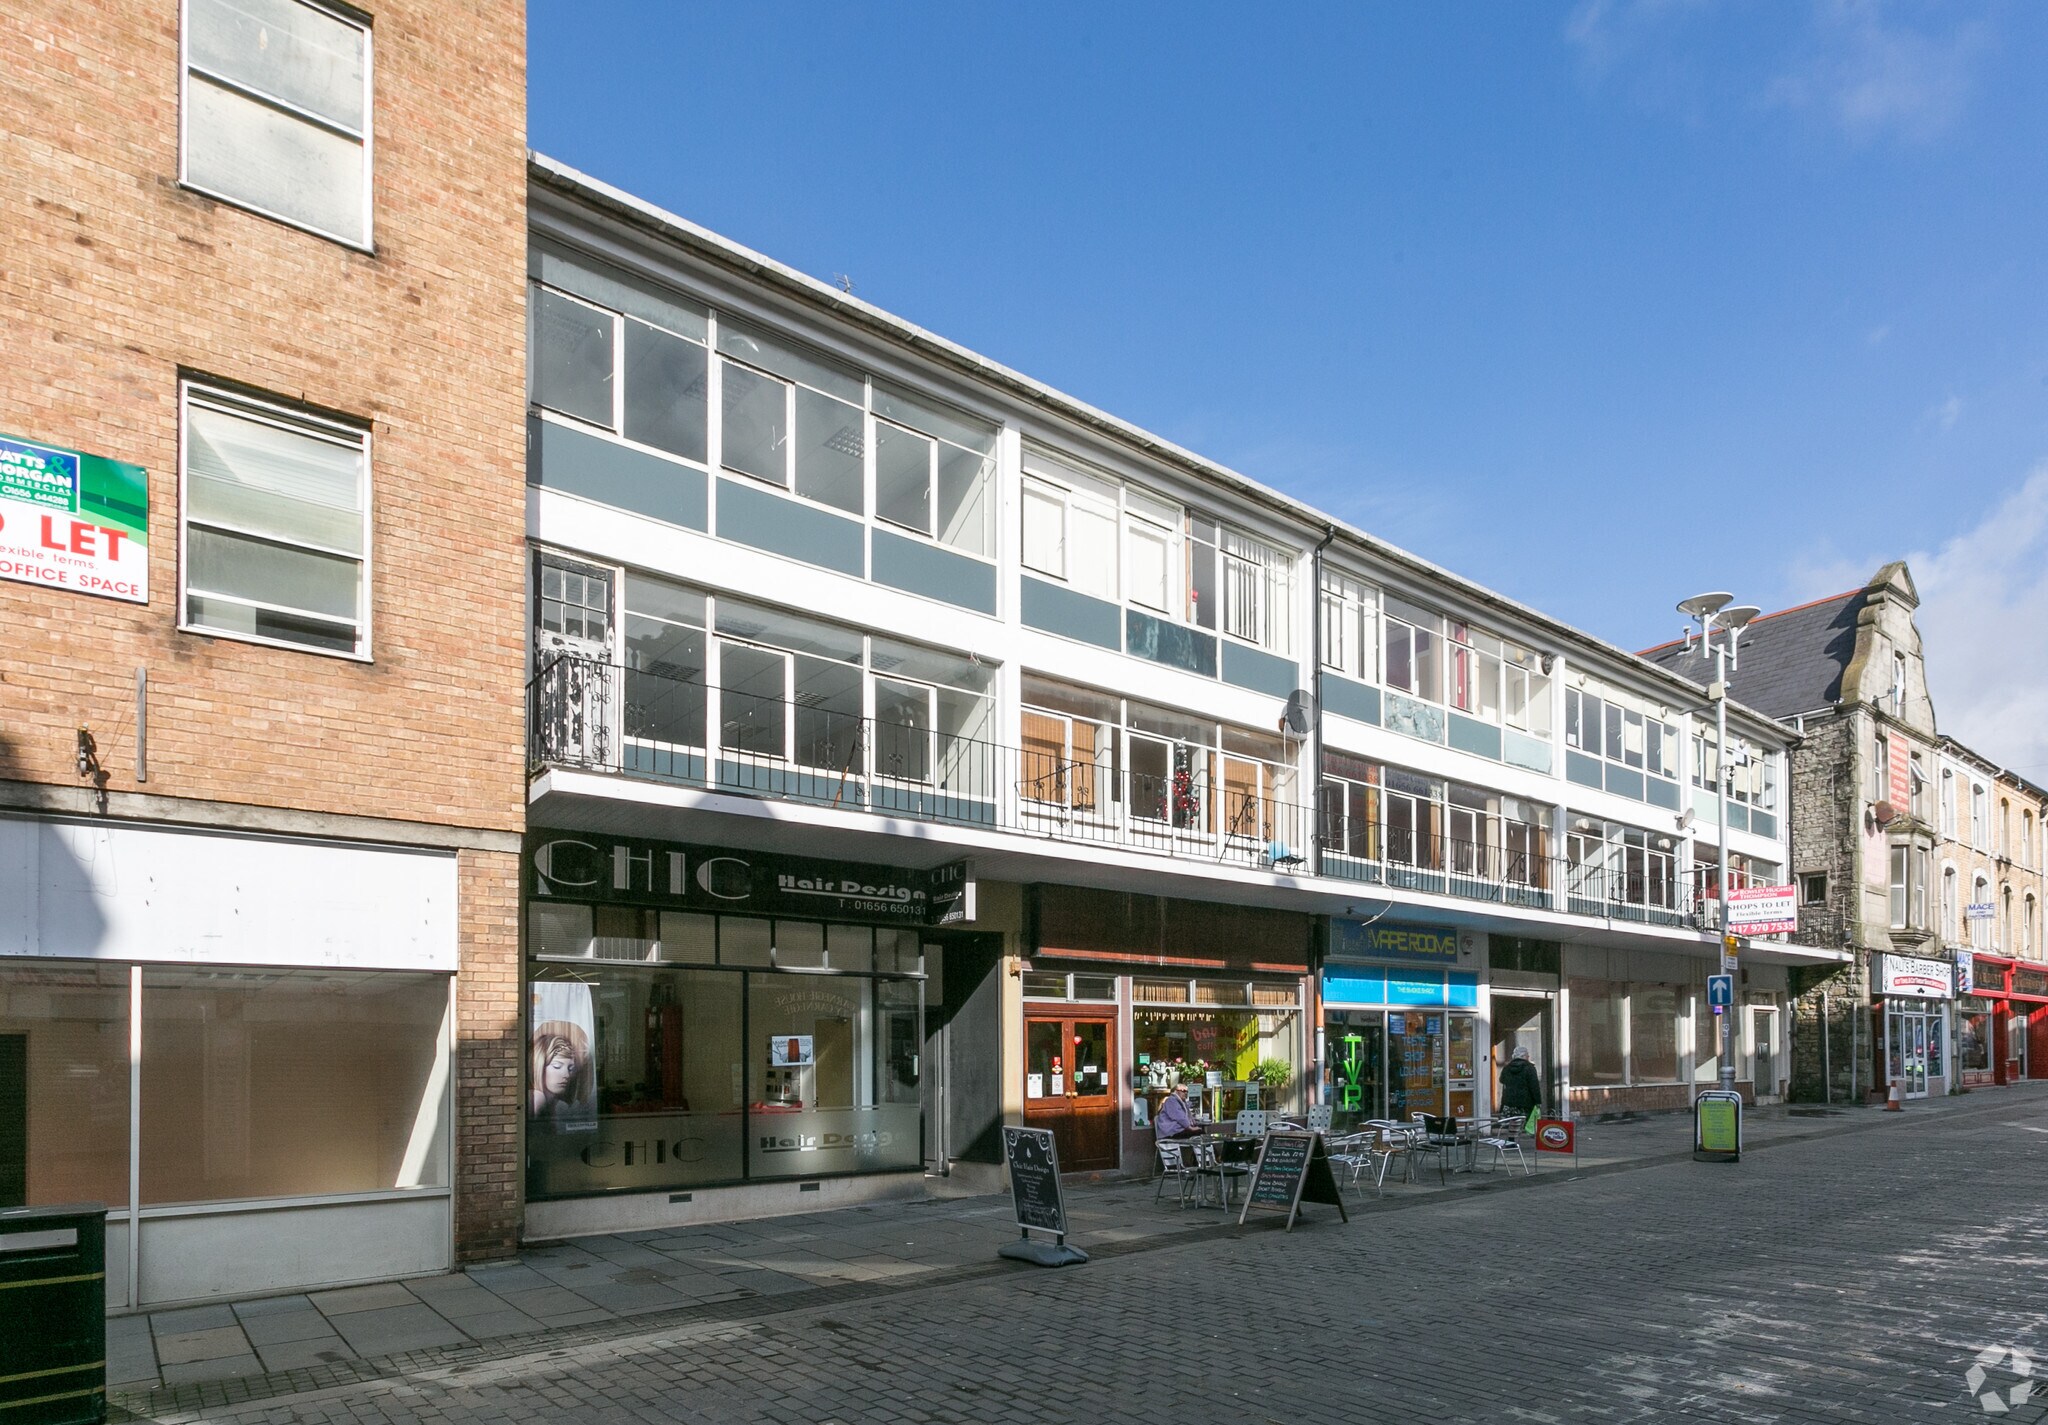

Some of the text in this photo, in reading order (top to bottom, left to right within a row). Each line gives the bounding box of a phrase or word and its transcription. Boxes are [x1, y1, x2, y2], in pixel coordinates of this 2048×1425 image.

[0, 449, 46, 469] ATTS
[0, 462, 73, 488] ORGAN
[41, 514, 128, 562] LET
[0, 560, 140, 597] OFFICE SPACE
[534, 839, 750, 899] CHIC
[778, 874, 926, 903] Hair Design
[854, 900, 887, 912] 01656
[890, 903, 926, 915] 650131
[1968, 902, 1995, 910] MACE
[1751, 924, 1768, 932] 970
[1771, 922, 1794, 931] 7535
[1408, 932, 1456, 955] ROOMS
[580, 1137, 704, 1168] CHIC
[760, 1133, 816, 1149] Hair
